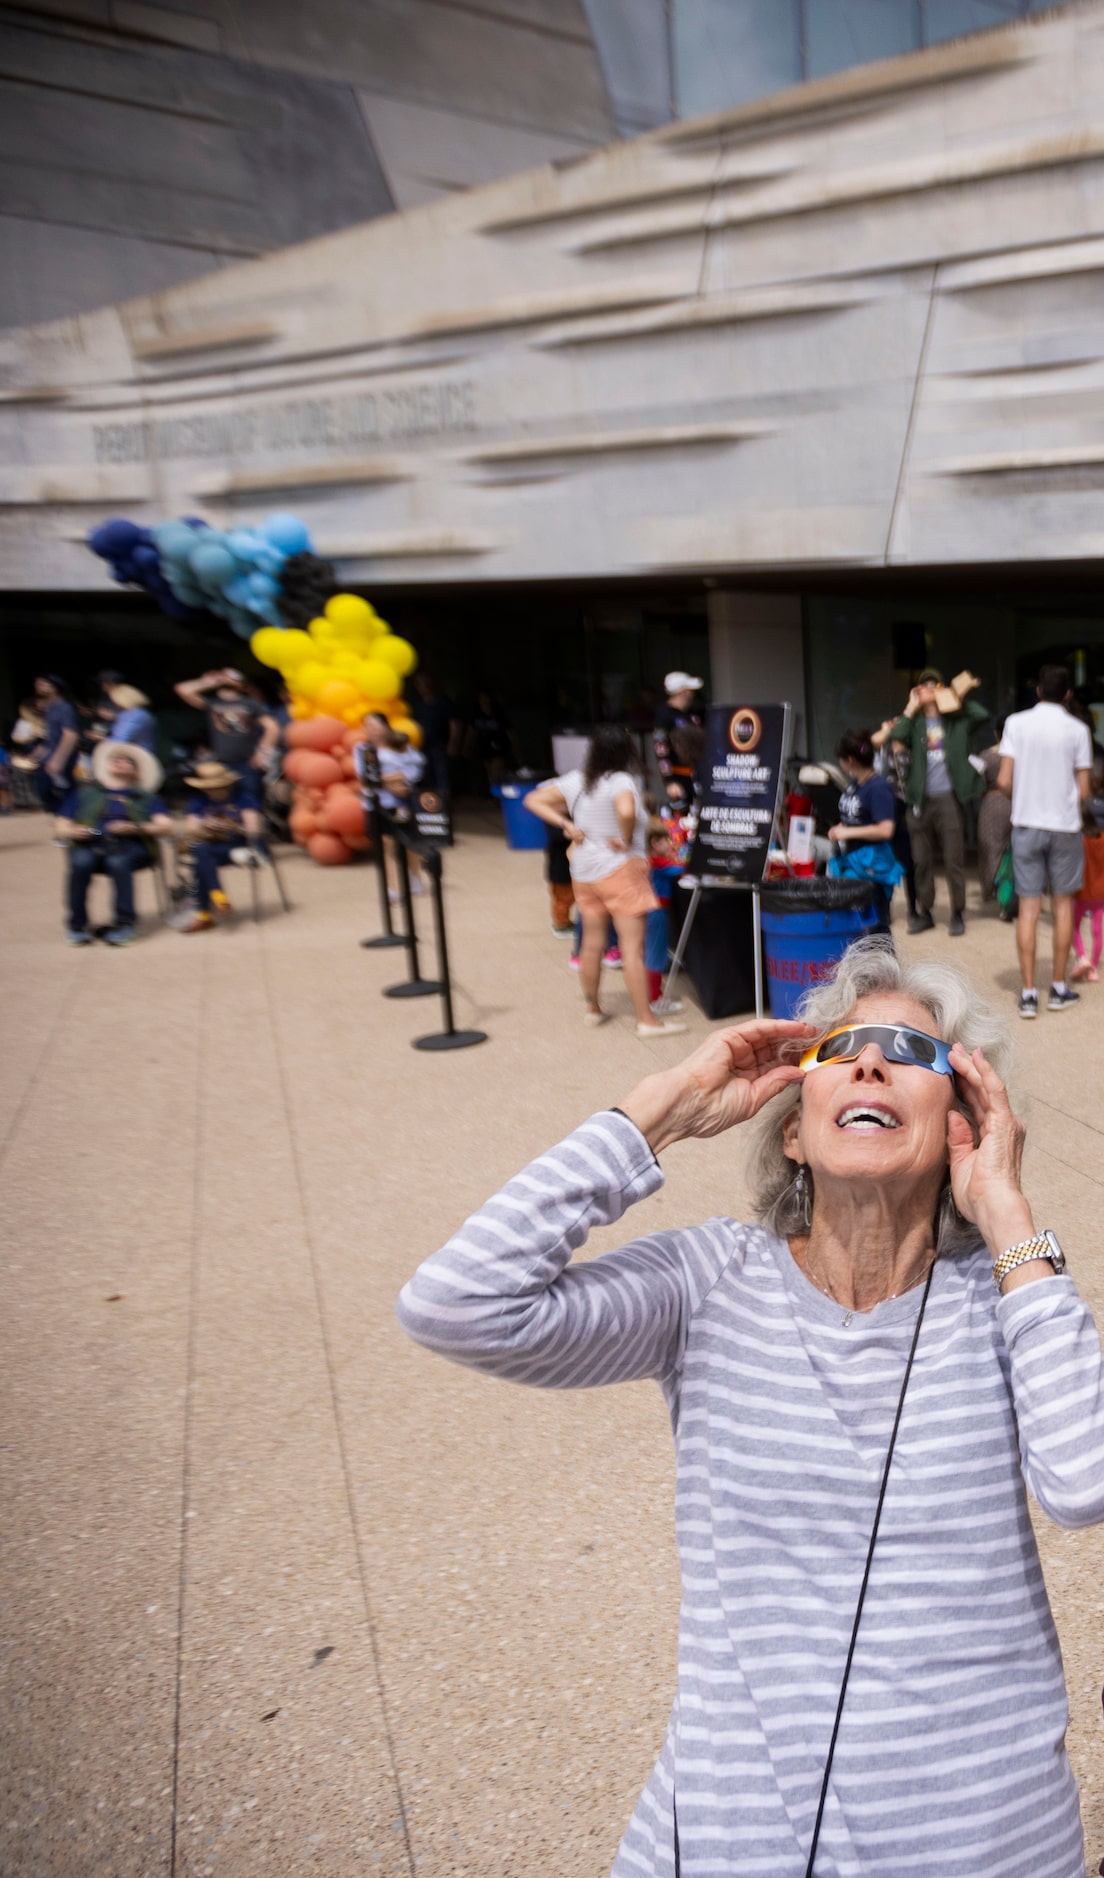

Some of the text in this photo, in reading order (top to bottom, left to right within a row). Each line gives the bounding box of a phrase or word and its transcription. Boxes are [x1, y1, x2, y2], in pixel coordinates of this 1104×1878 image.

[726, 753, 757, 767] SHADOW
[712, 766, 769, 781] SCULPTURE ART
[701, 806, 719, 820] ARTE
[729, 807, 770, 822] ESCULTURA
[721, 821, 756, 835] SOMBRAS
